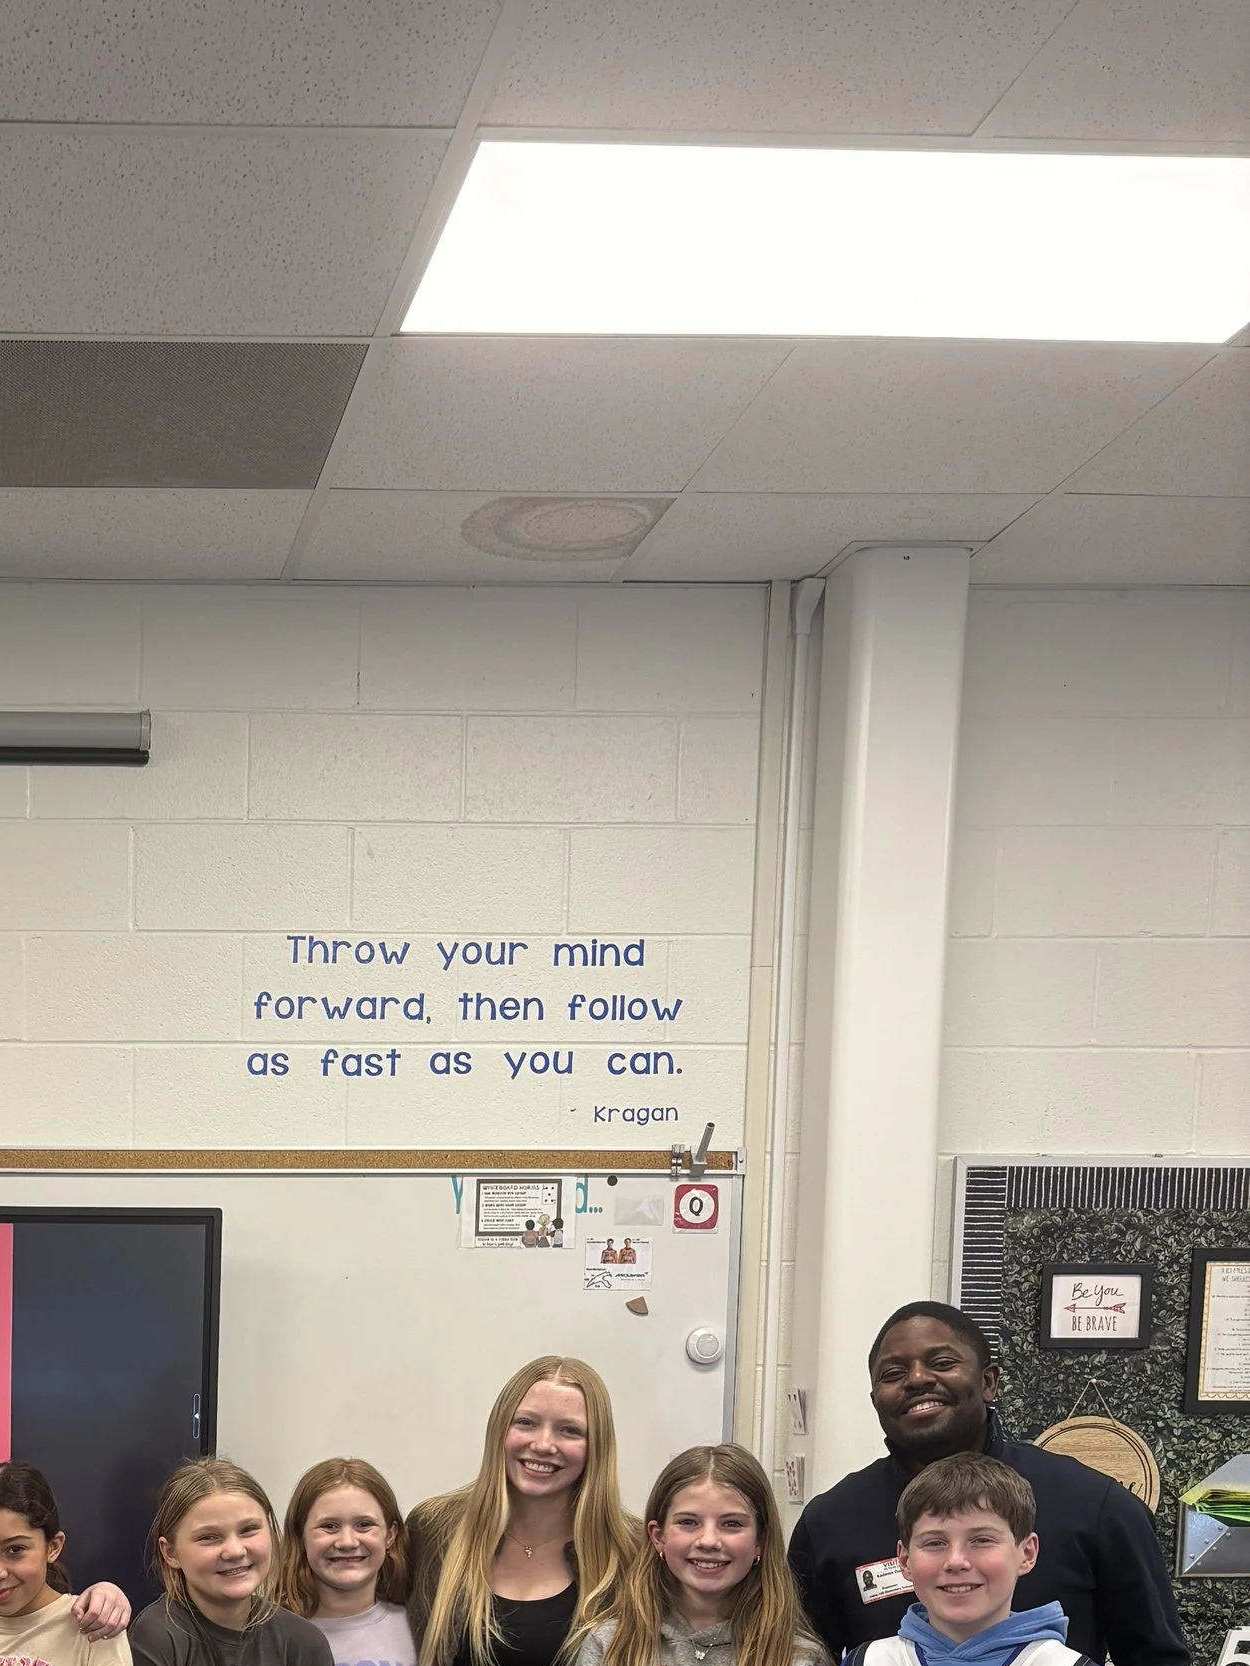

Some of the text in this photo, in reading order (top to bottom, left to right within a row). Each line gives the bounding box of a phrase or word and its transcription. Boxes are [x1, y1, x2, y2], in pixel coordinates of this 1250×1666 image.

[286, 935, 645, 972] Throw your mind
[253, 991, 683, 1025] forward, then follow
[246, 1048, 682, 1078] as fast as you can.
[593, 1104, 679, 1125] Kragan
[688, 1196, 705, 1217] Q
[1071, 1282, 1124, 1307] Be You
[1072, 1316, 1117, 1331] BE BRAVE
